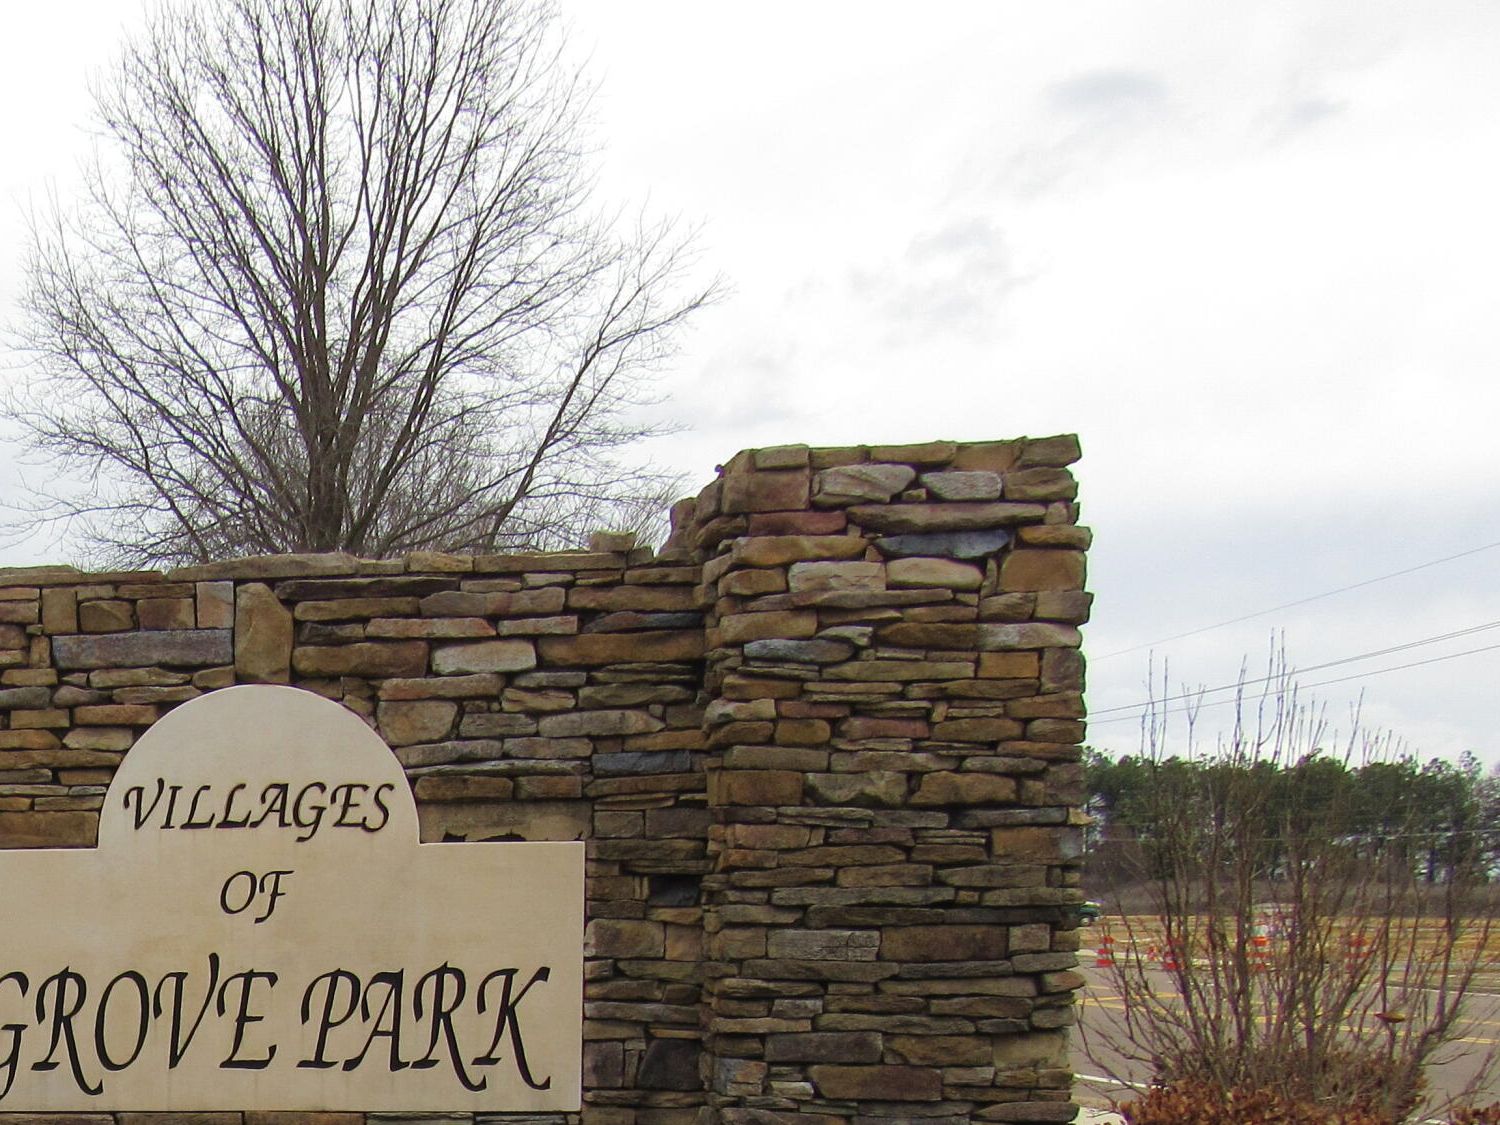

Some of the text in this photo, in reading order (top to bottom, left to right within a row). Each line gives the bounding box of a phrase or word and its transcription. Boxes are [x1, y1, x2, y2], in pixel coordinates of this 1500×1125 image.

[122, 777, 394, 843] VILLAGES
[219, 869, 295, 924] OF
[296, 960, 552, 1092] PARK
